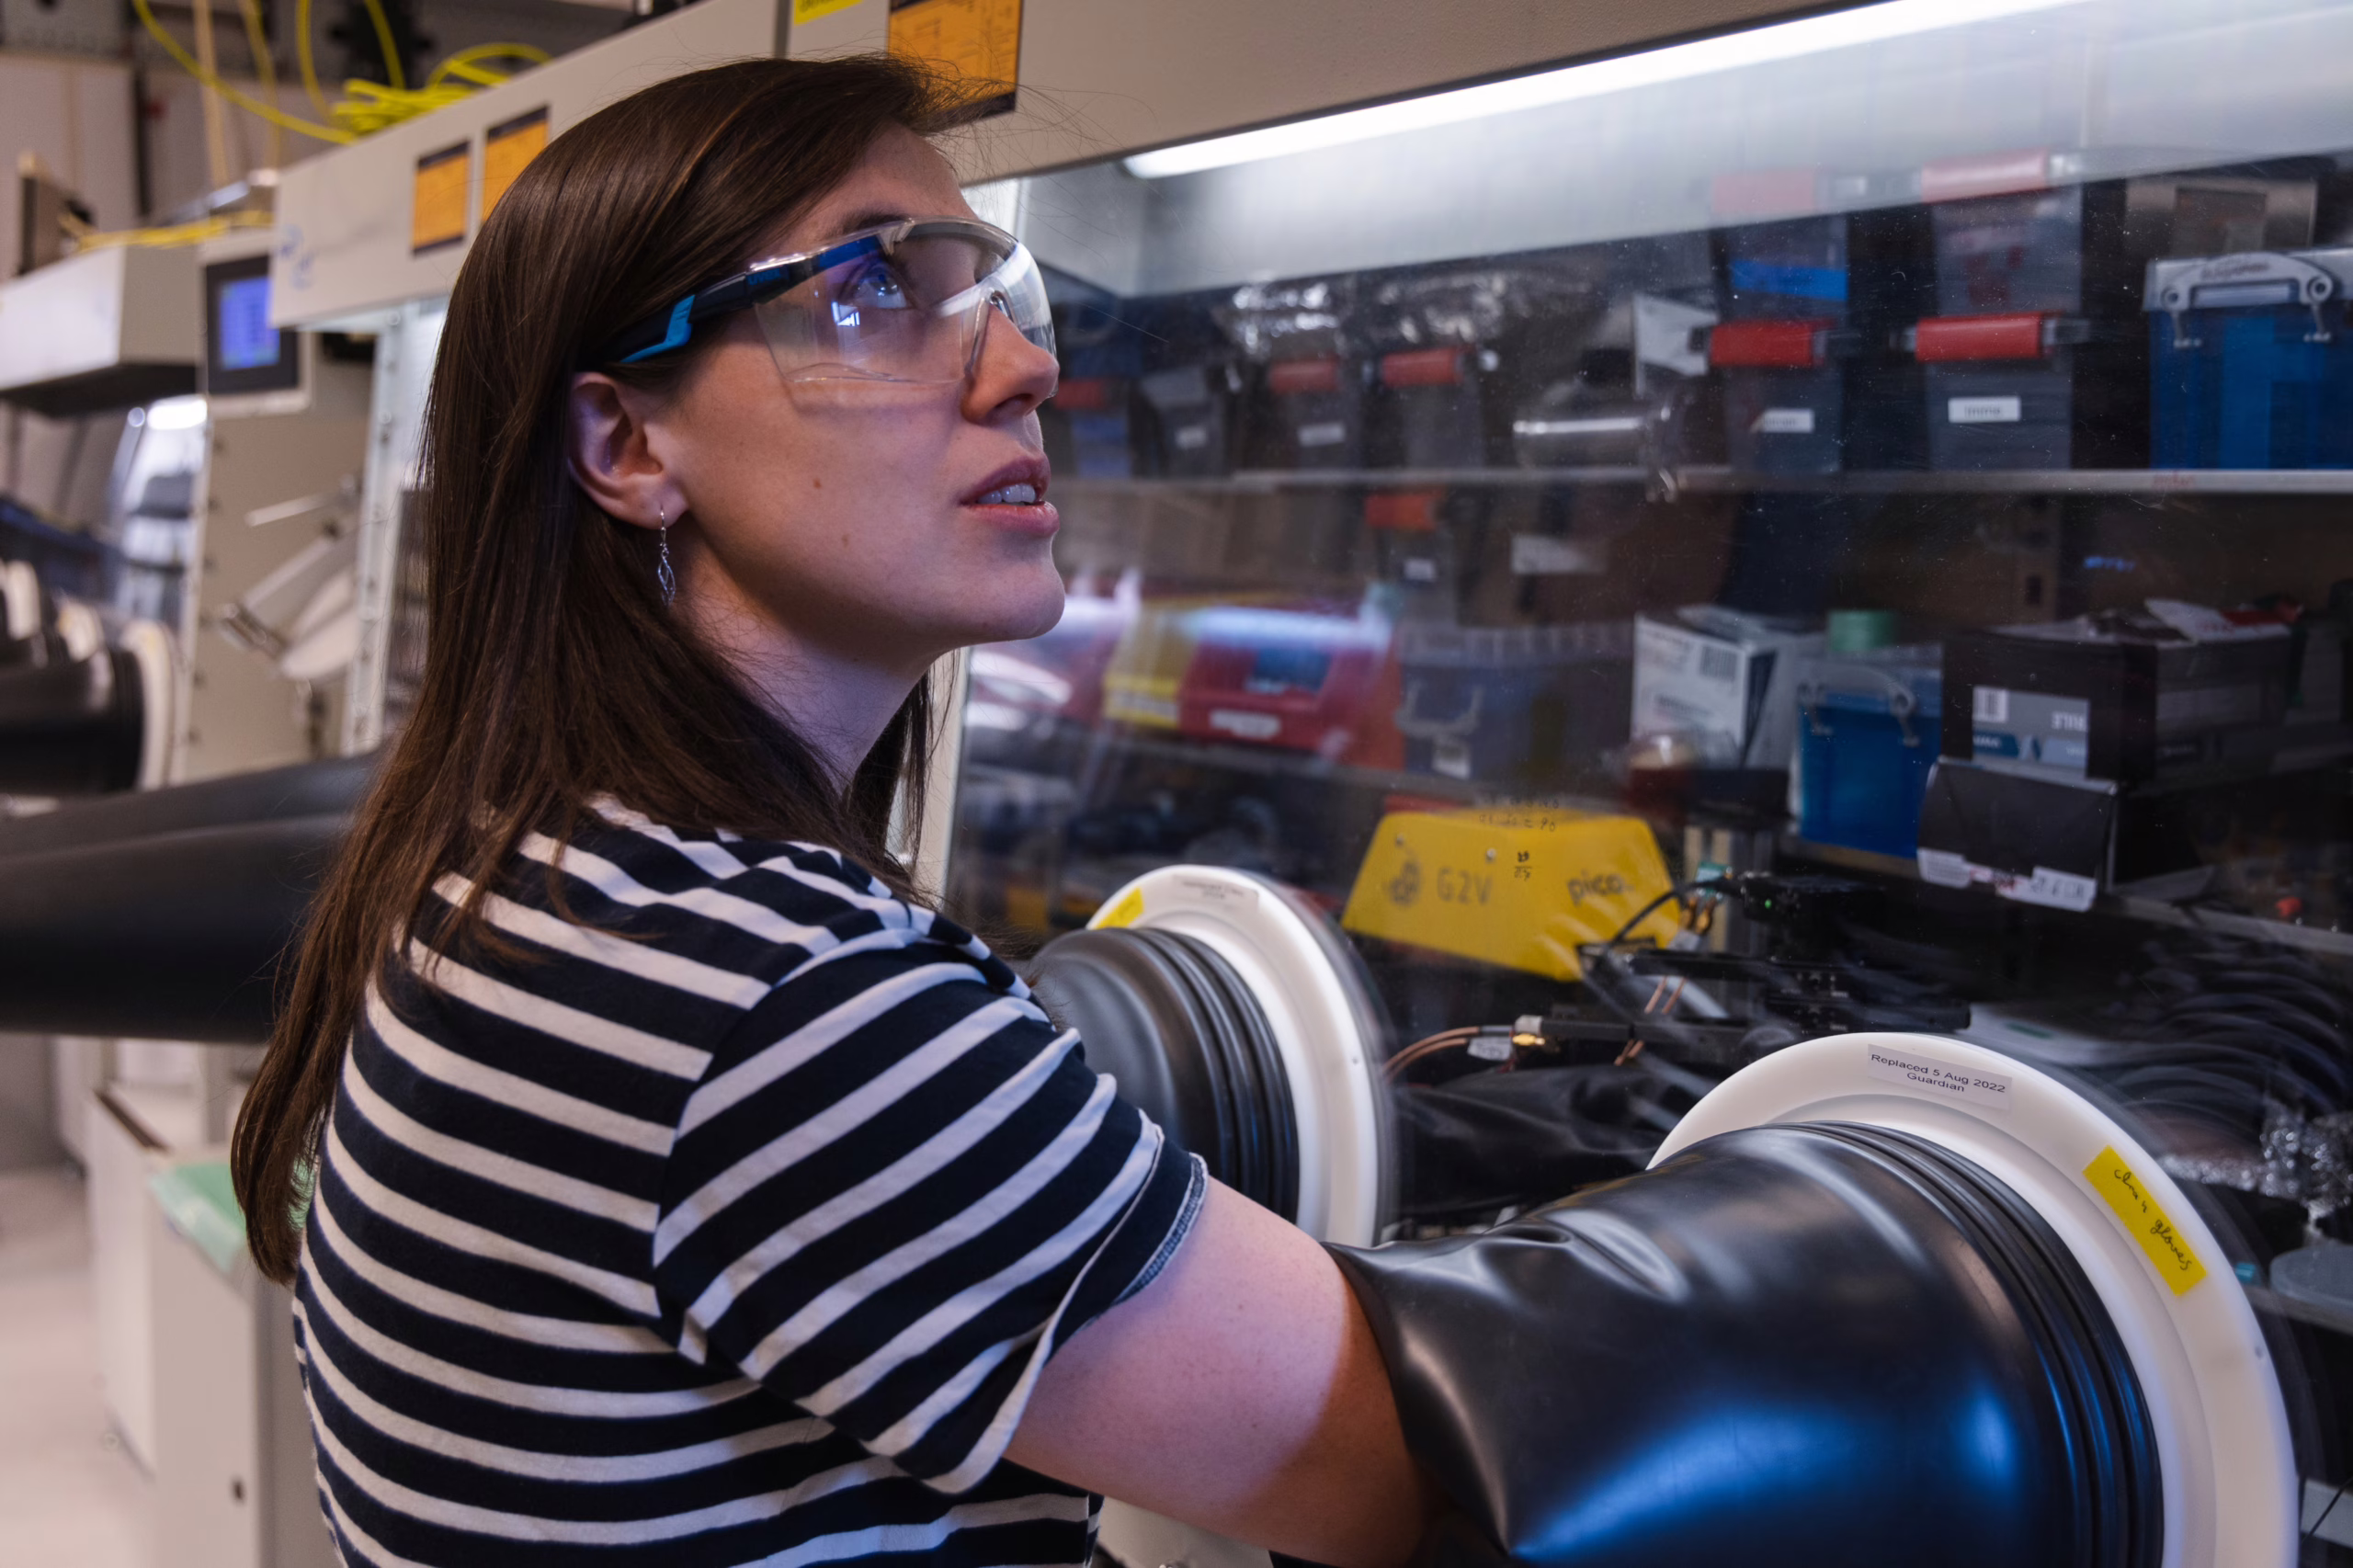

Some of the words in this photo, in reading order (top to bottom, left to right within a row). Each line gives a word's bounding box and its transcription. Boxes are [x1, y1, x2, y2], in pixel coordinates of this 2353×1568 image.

[1437, 865, 1493, 906] G2V
[1870, 1053, 1928, 1073] Replaced
[1932, 1067, 1940, 1076] 5
[1944, 1072, 1969, 1085] Aug
[1972, 1078, 2006, 1093] 2022
[1906, 1072, 1964, 1092] Guardian
[2150, 1219, 2192, 1270] gloves
